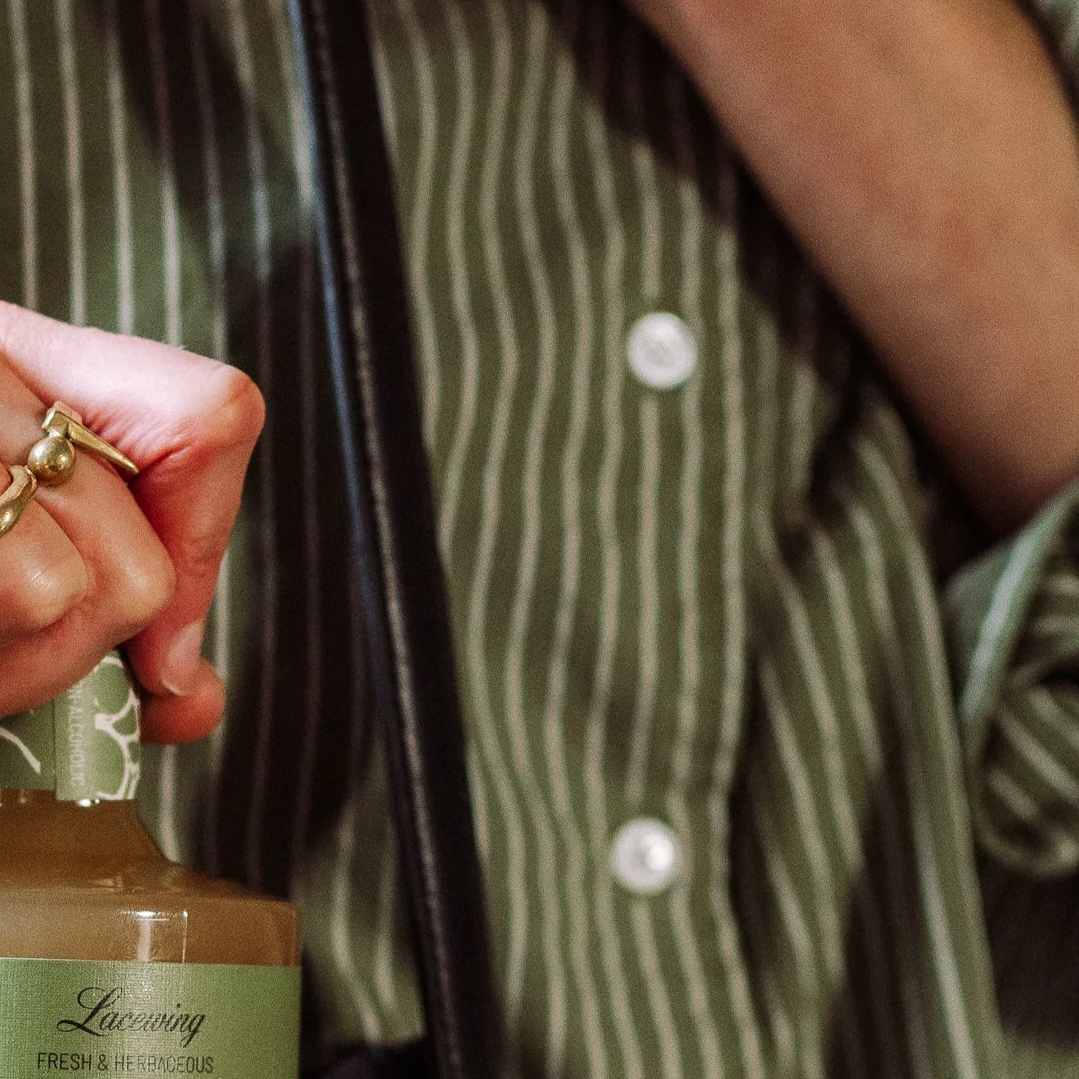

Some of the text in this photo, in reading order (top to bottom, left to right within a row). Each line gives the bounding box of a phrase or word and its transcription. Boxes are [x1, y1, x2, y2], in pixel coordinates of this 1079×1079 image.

[56, 986, 206, 1048] Lacewing
[37, 1052, 214, 1074] FRESH & HERBACEOUS
